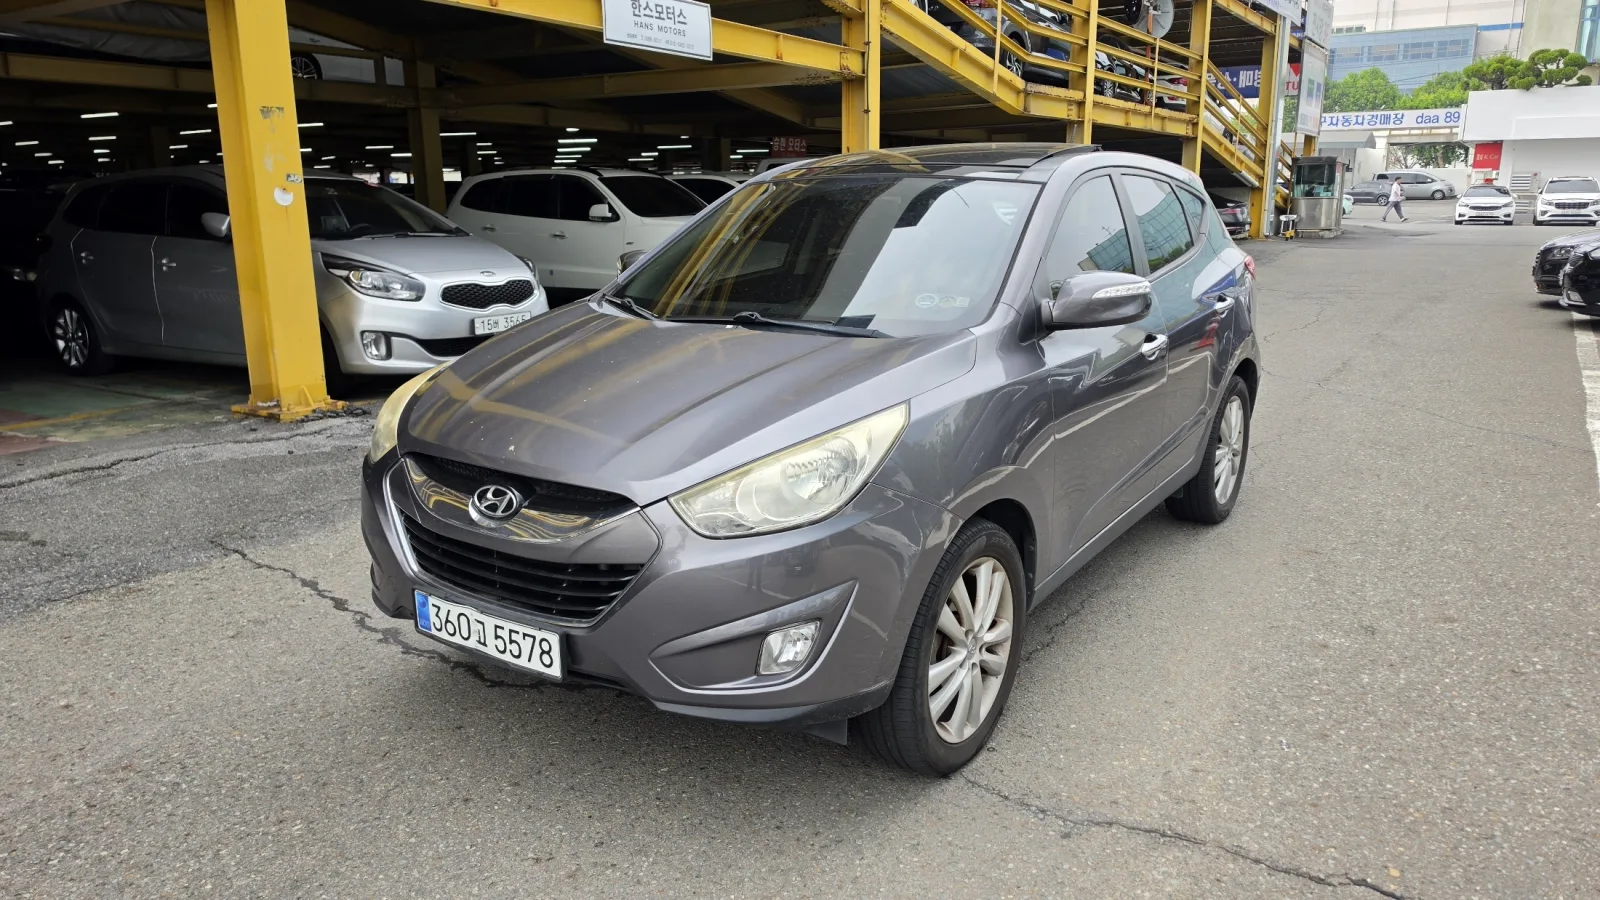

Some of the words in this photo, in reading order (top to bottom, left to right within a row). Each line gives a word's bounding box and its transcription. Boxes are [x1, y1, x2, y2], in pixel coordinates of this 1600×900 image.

[631, 0, 687, 25] 한스모터스
[634, 20, 653, 31] HANS
[657, 25, 686, 37] MOTORS
[1416, 112, 1439, 124] daa
[1444, 111, 1460, 124] 89
[431, 603, 488, 647] 360고
[494, 624, 554, 669] 5578
